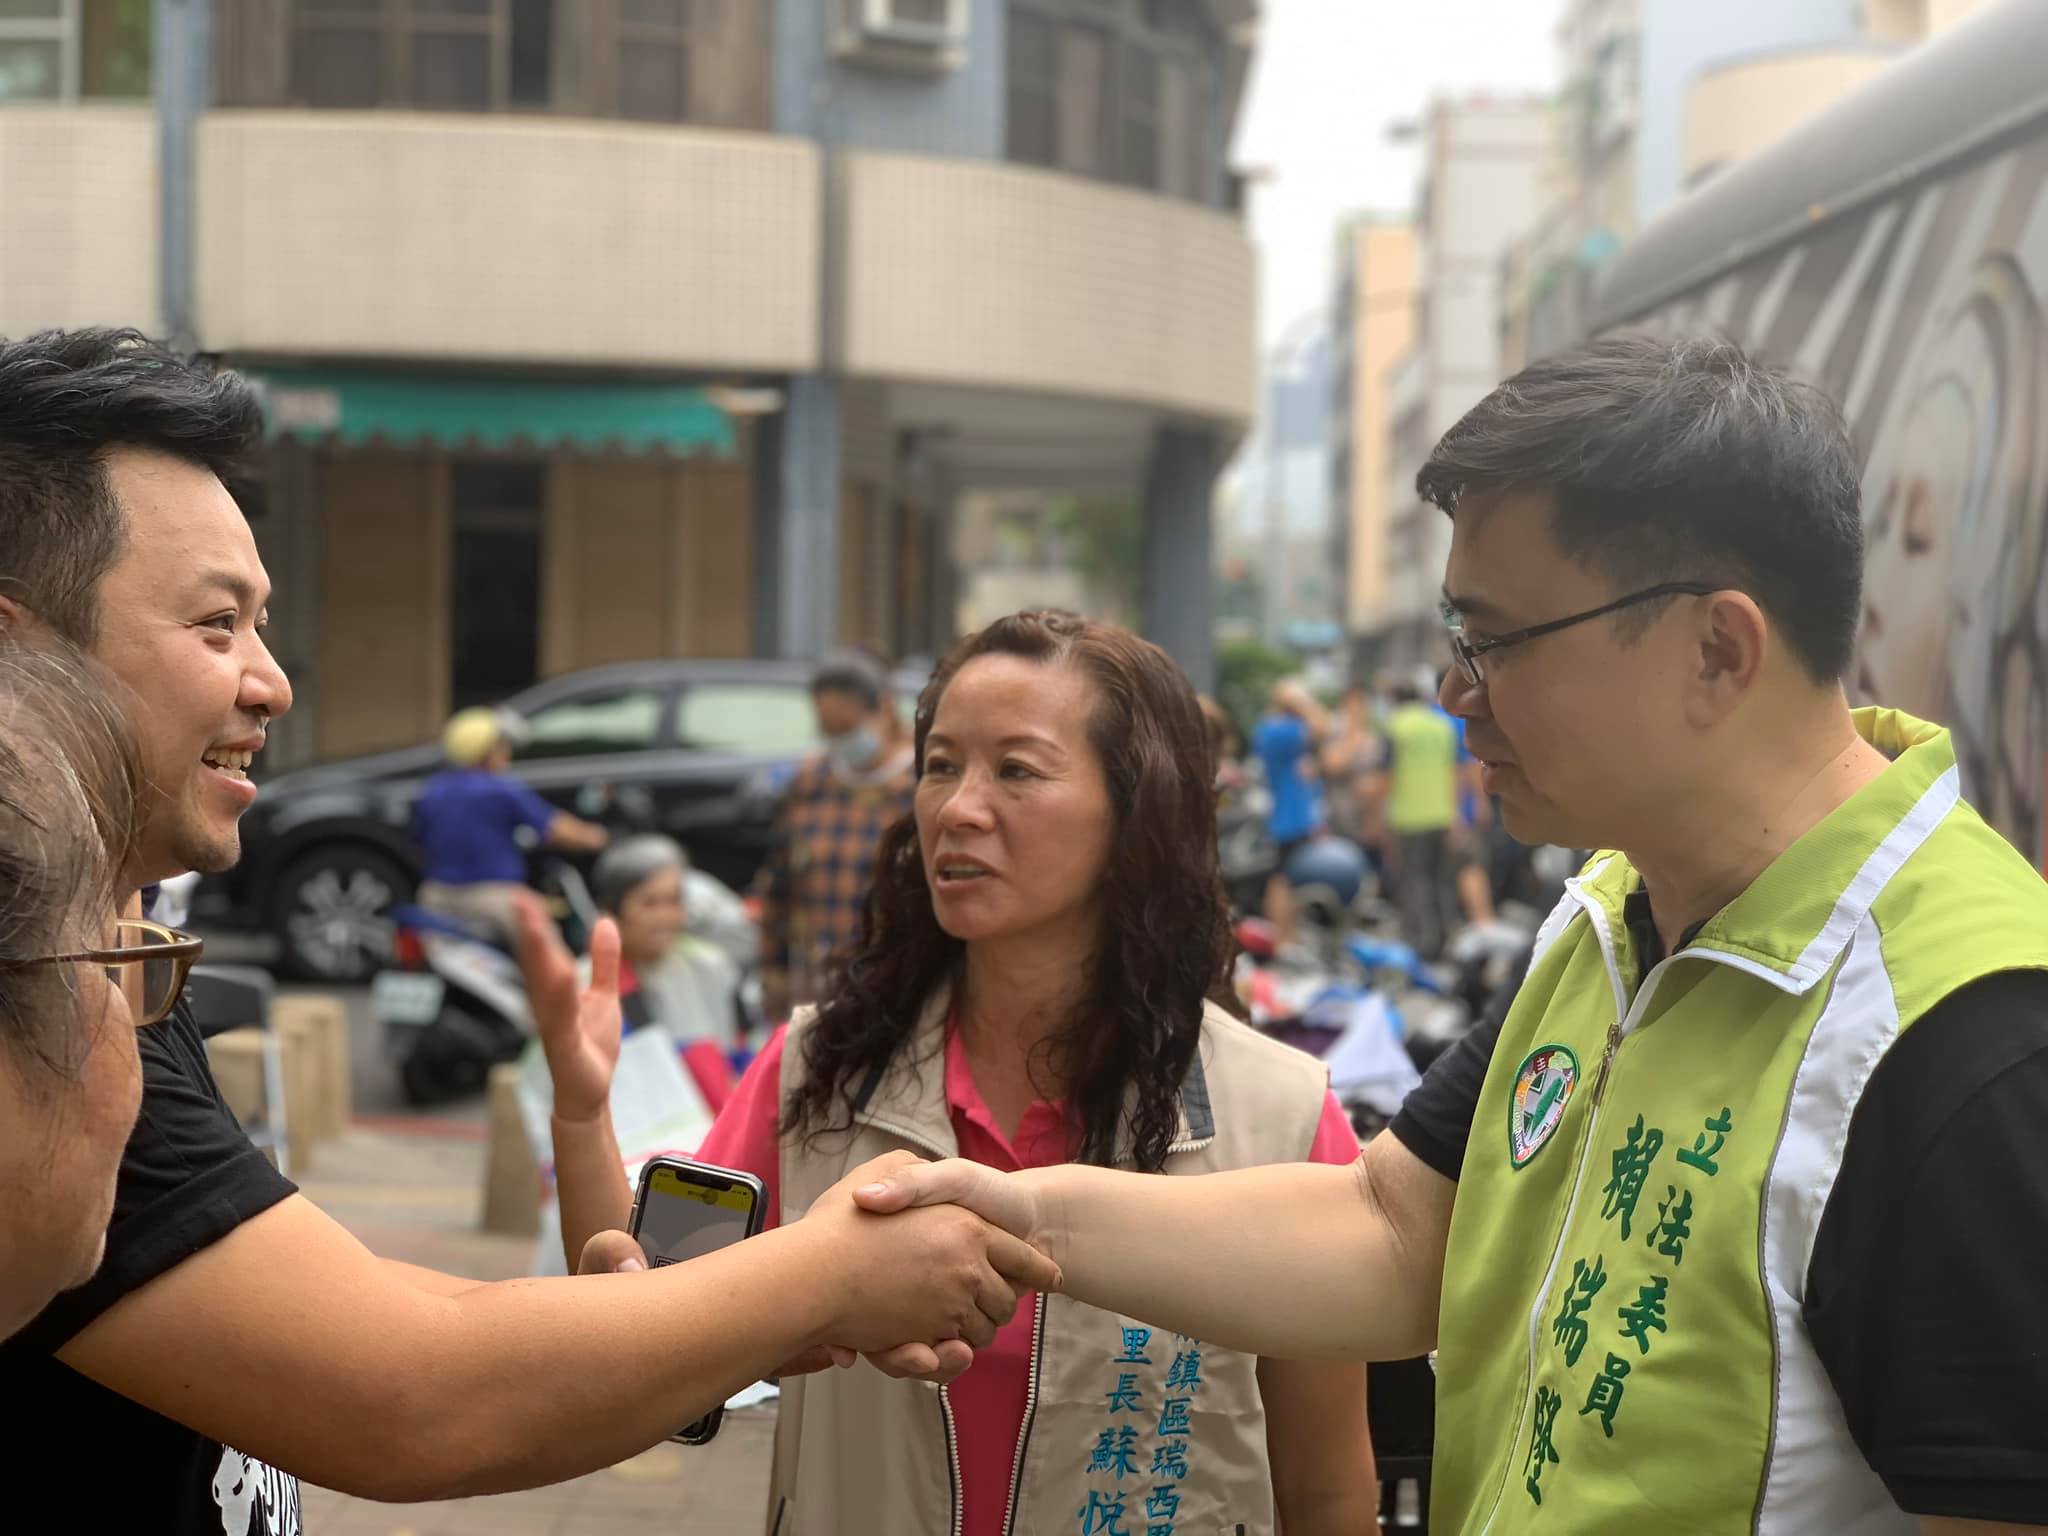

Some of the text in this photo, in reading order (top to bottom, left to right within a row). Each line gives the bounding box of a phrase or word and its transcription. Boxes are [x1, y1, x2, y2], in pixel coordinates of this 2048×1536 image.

[1146, 1333, 1203, 1536] 鎮區瑞西
[1523, 1113, 1664, 1505] 賴瑞隆
[1578, 1106, 1733, 1438] 立法委員
